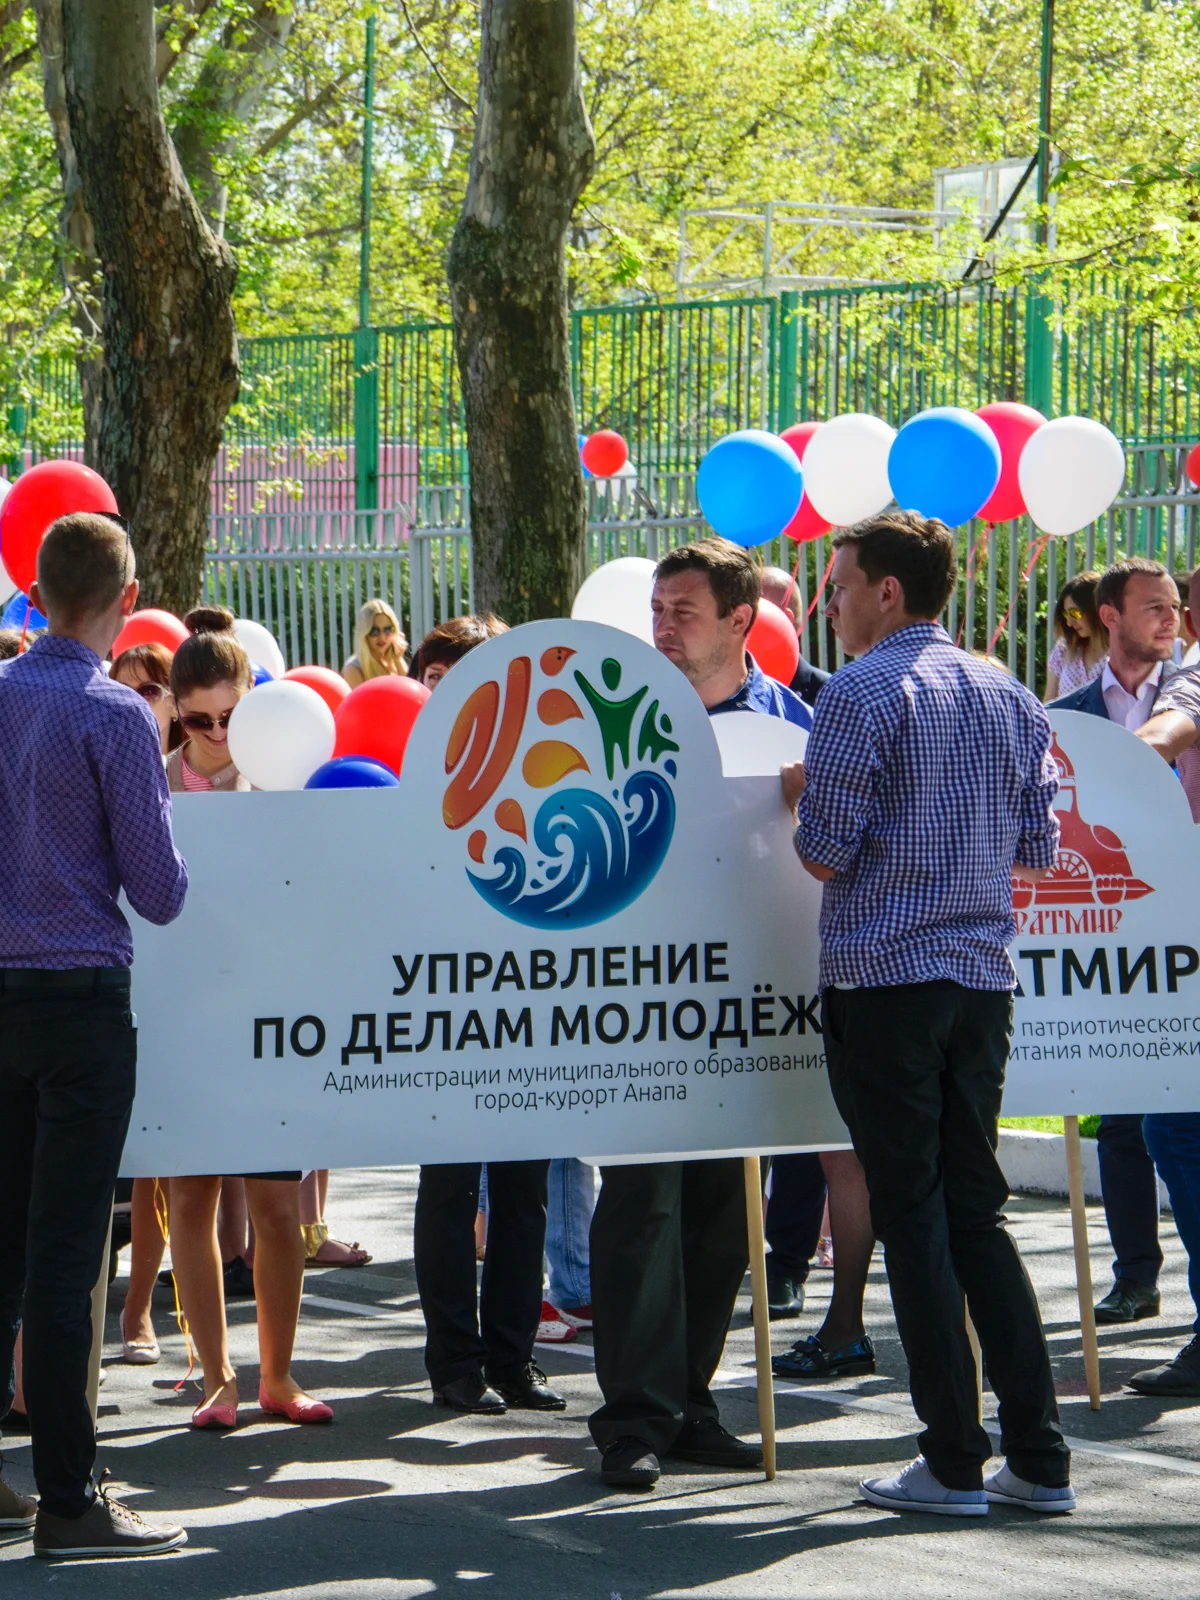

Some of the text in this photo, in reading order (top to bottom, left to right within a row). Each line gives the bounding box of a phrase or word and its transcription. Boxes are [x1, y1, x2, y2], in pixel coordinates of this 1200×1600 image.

[392, 942, 730, 997] УПРАВЛЕНИЕ
[1013, 945, 1200, 998] ТМИР
[253, 1014, 326, 1059] ПО
[341, 1007, 533, 1066] ДЕЛАМ
[1021, 1016, 1200, 1041] патриотического
[1089, 1036, 1200, 1061] молодёжи
[323, 1052, 828, 1095] Администрации муниципального образования
[475, 1083, 687, 1113] город-курорт Анапа
